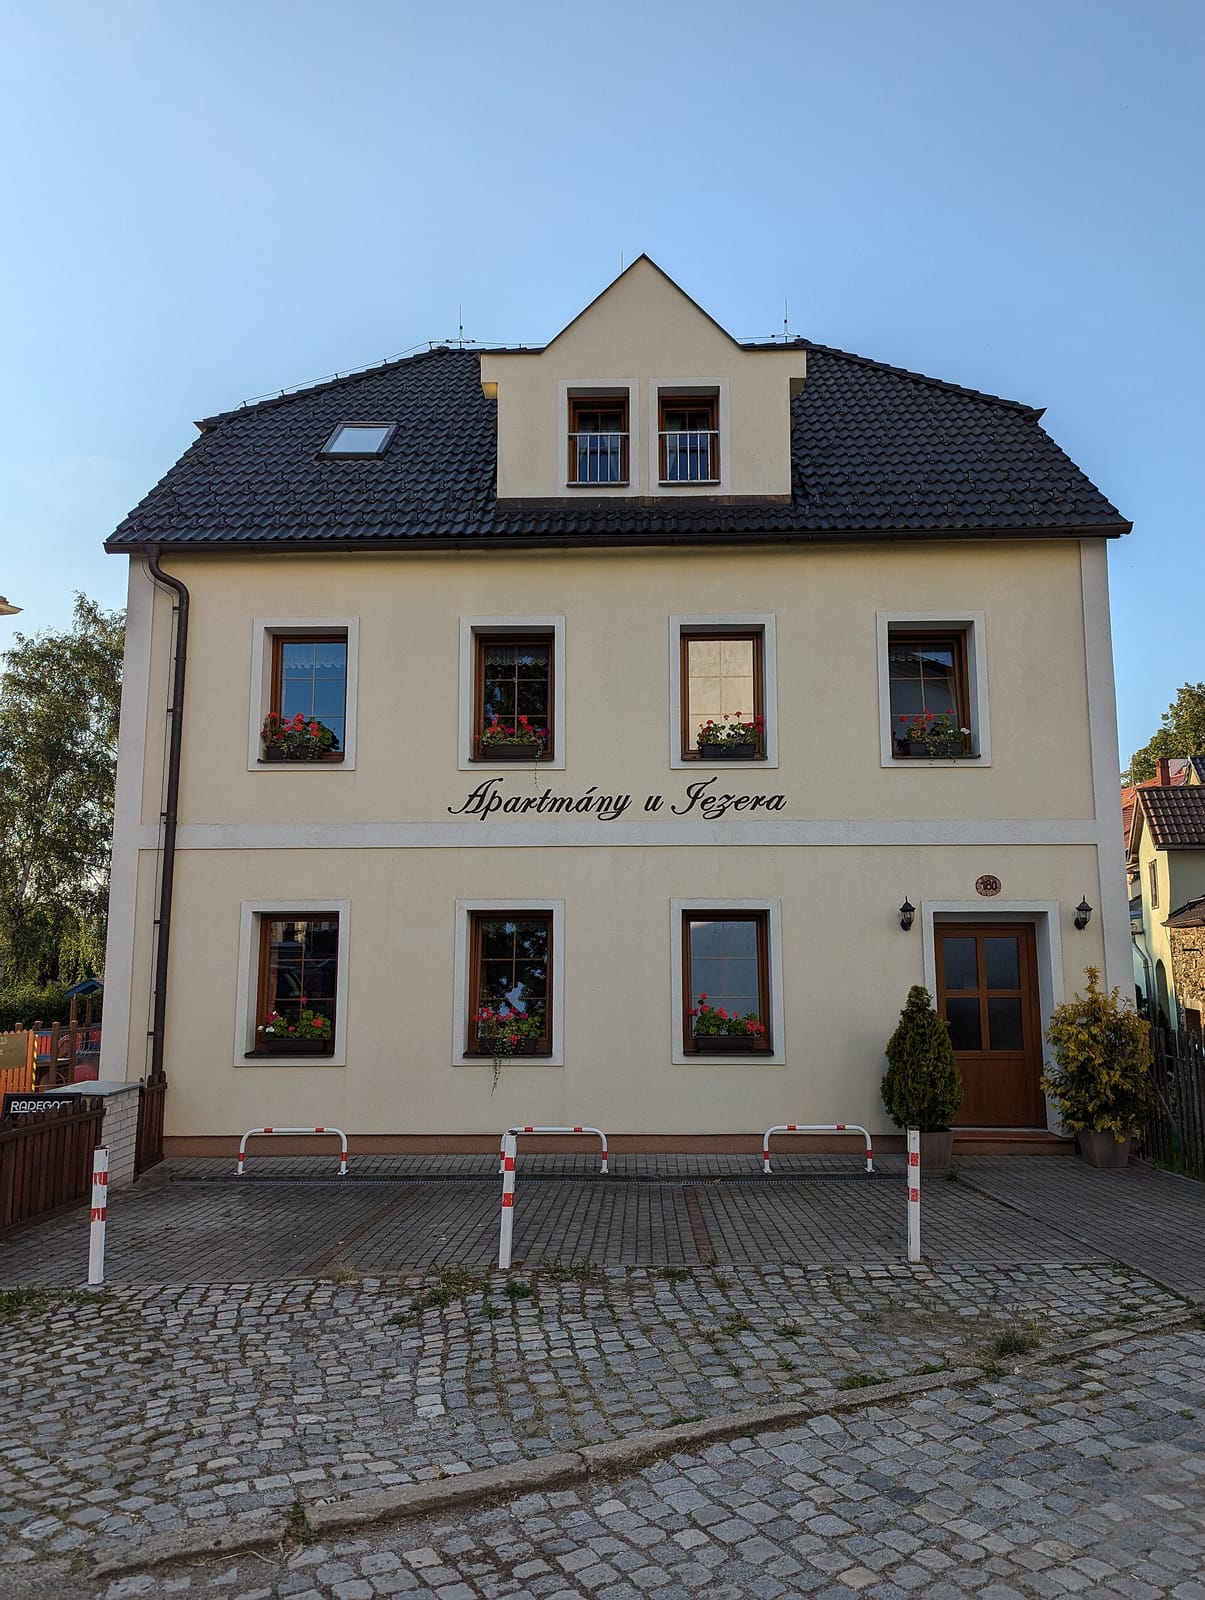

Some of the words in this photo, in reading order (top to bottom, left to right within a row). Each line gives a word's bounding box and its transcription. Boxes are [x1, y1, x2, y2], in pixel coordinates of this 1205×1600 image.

[447, 777, 632, 821] Apartmány
[644, 795, 664, 811] u
[670, 776, 787, 820] Jezera
